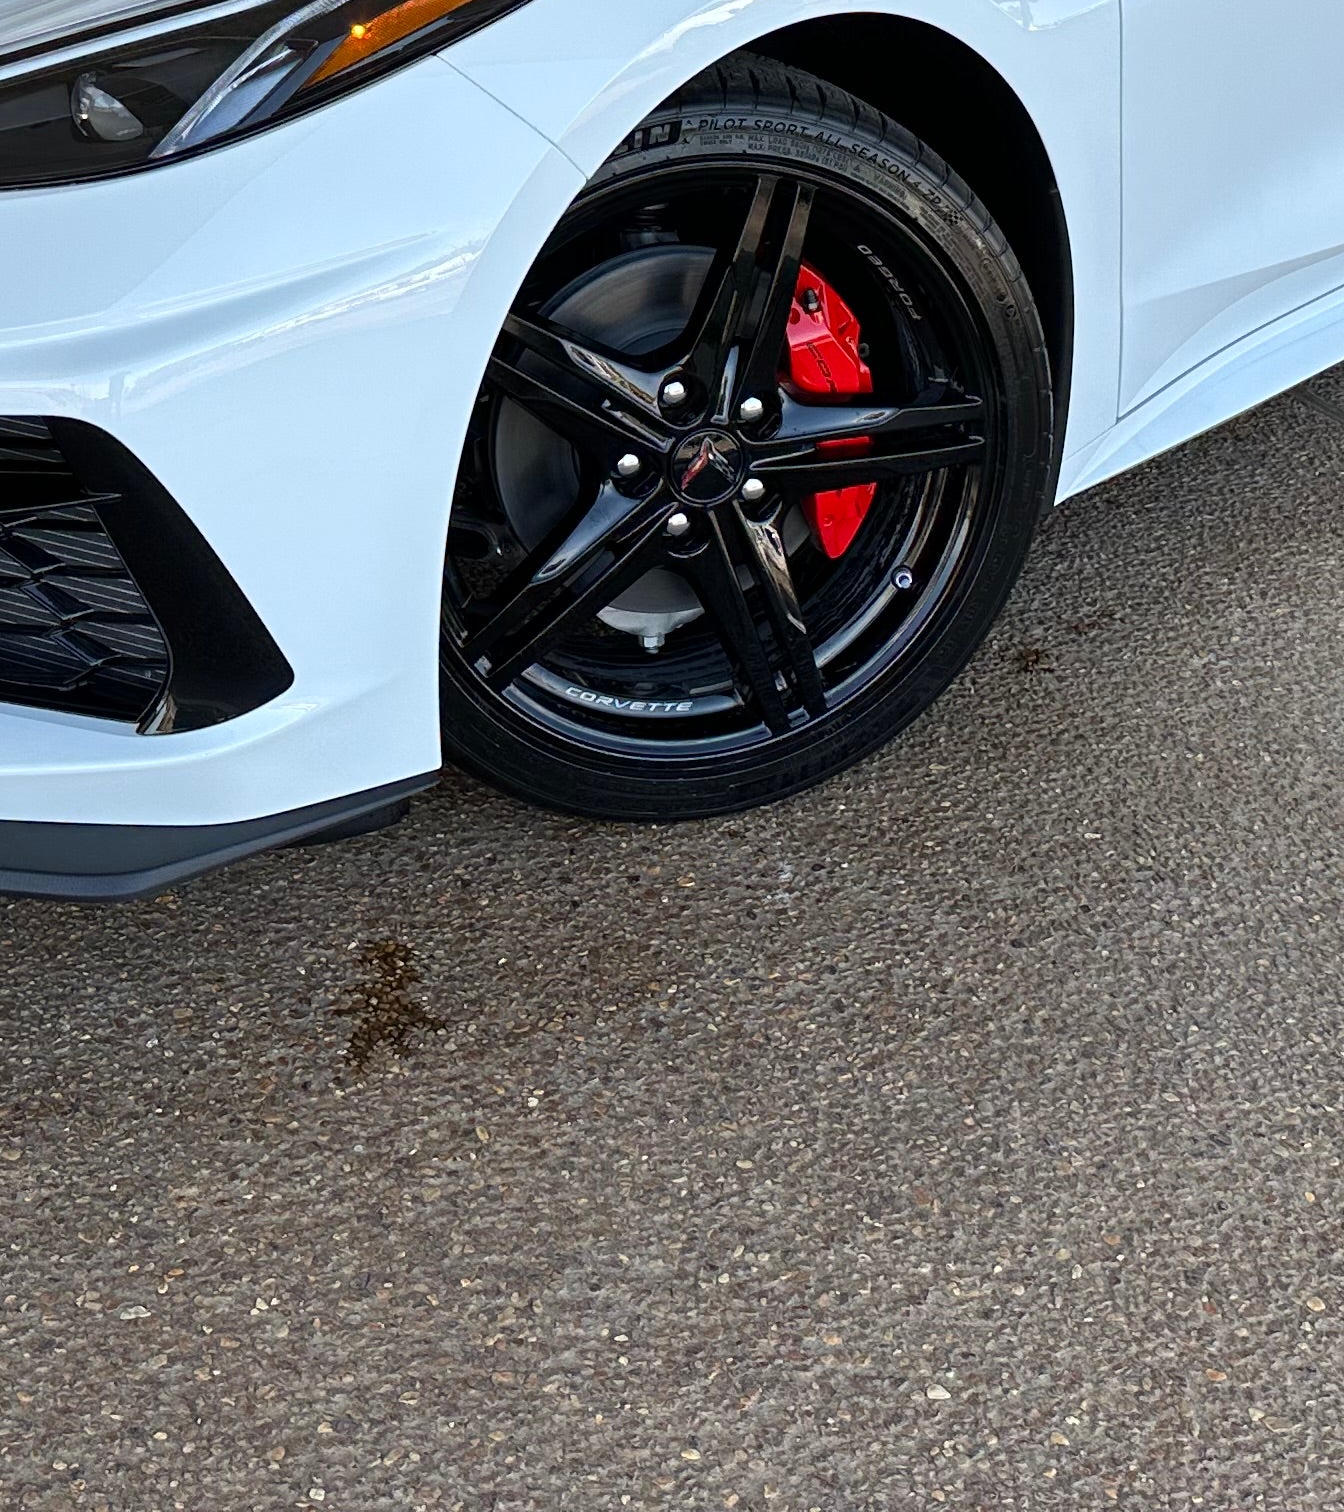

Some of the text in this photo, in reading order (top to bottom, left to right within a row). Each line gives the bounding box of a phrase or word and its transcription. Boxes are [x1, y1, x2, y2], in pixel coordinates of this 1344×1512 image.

[697, 117, 748, 132] PILOT
[752, 118, 811, 138] SPORT
[813, 130, 844, 150] ALL
[848, 142, 913, 184] SEASON
[856, 243, 923, 321] FORGED
[564, 686, 695, 713] CORVETTE
